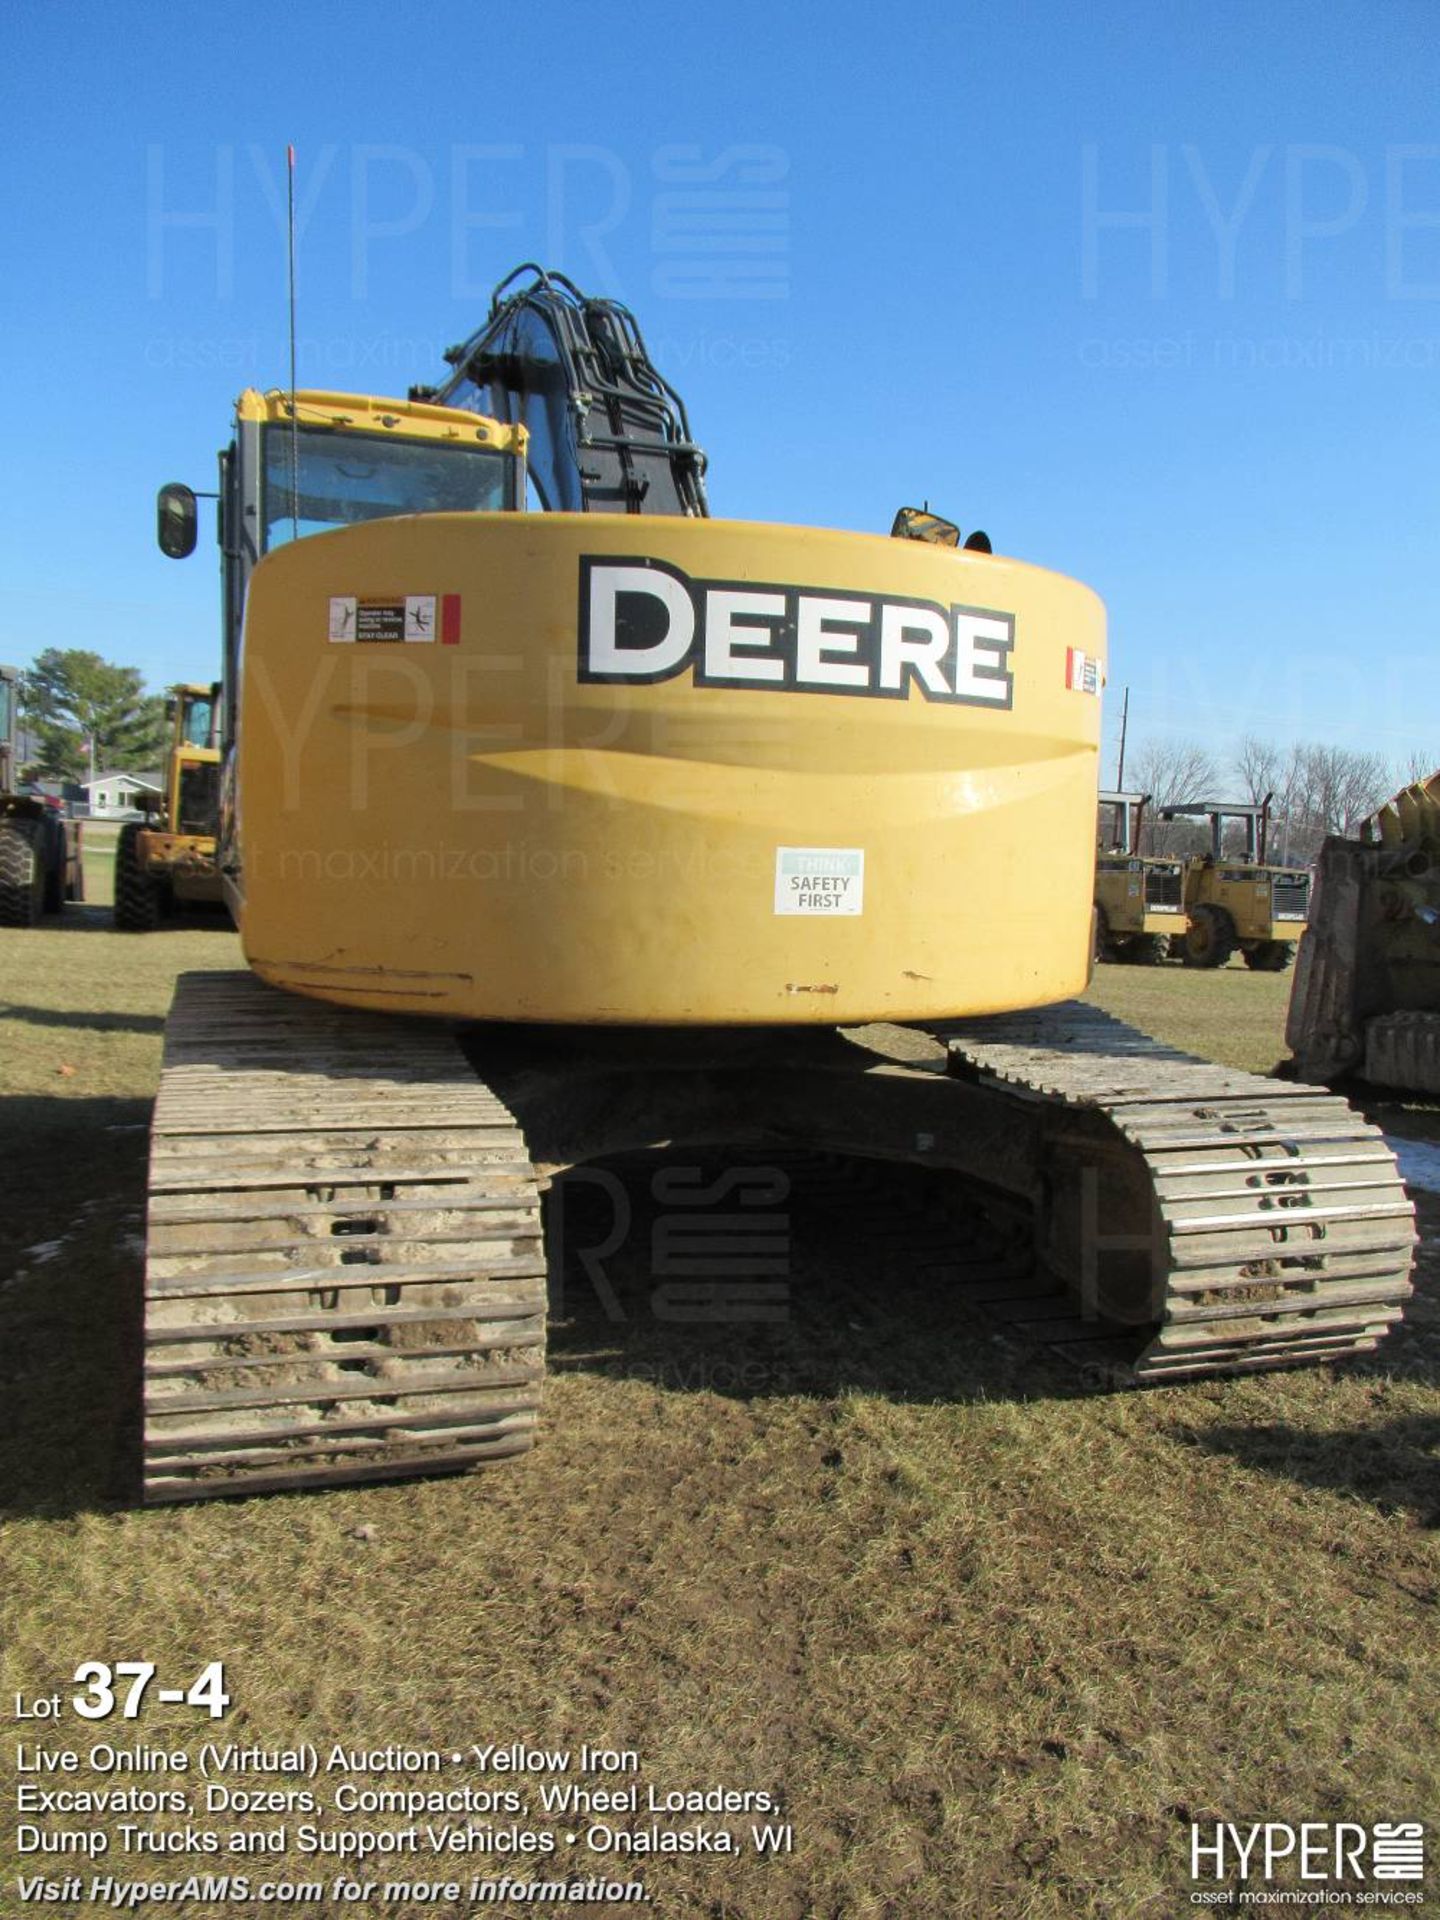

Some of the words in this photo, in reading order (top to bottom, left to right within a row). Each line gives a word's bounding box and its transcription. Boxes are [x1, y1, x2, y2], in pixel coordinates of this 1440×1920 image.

[589, 566, 1010, 700] DEERE
[798, 856, 850, 873] THINK
[790, 876, 850, 891] SAFETY
[798, 893, 842, 908] FIRST
